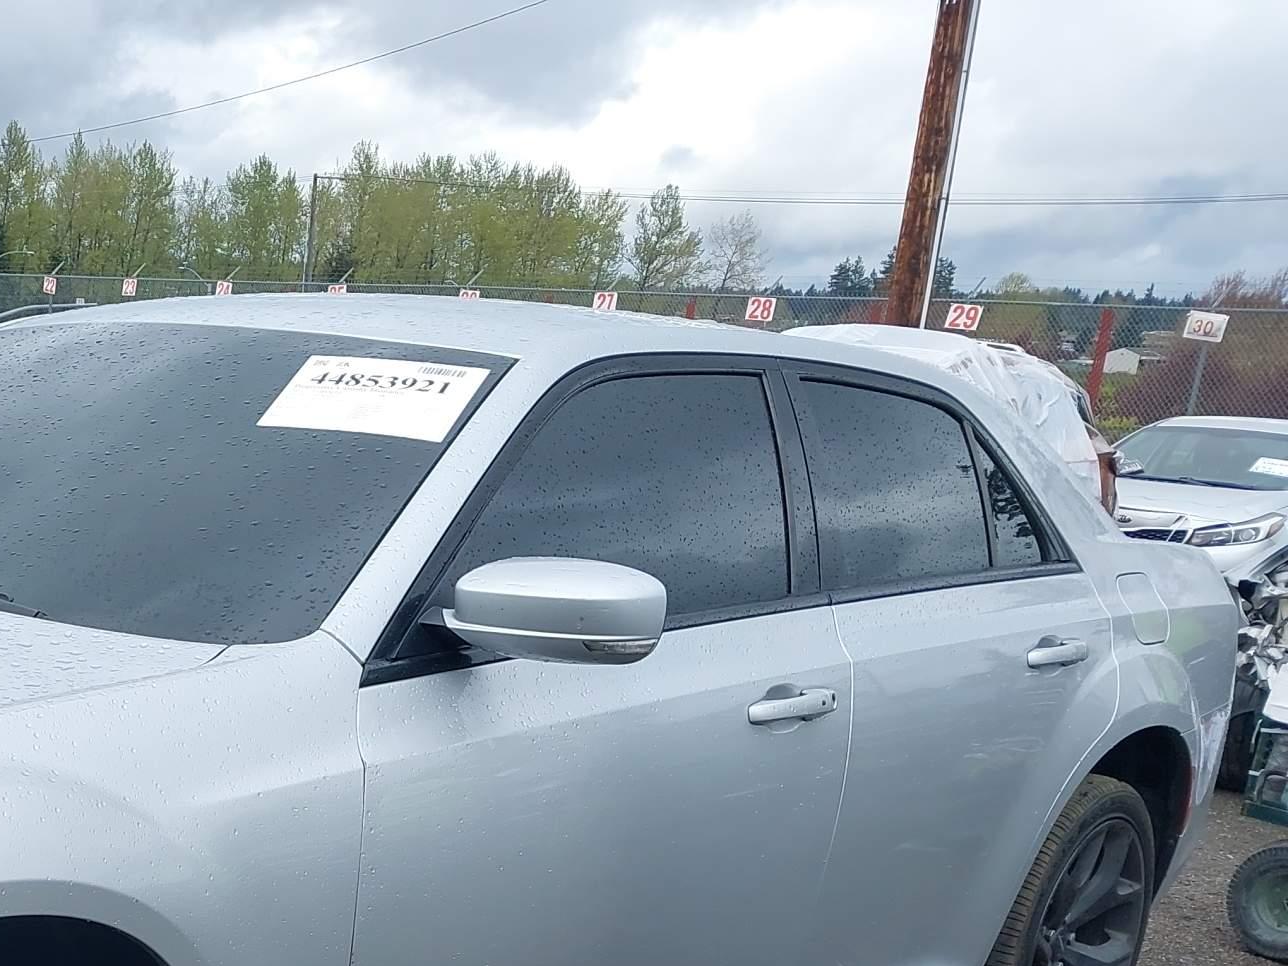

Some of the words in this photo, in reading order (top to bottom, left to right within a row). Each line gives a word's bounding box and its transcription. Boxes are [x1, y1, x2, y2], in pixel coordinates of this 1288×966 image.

[45, 278, 55, 293] 22
[123, 280, 136, 295] 23
[217, 282, 231, 296] 24
[597, 293, 615, 310] 27
[748, 299, 773, 320] 28
[948, 305, 980, 329] 29
[1193, 319, 1214, 335] 30
[310, 372, 451, 394] 44853921
